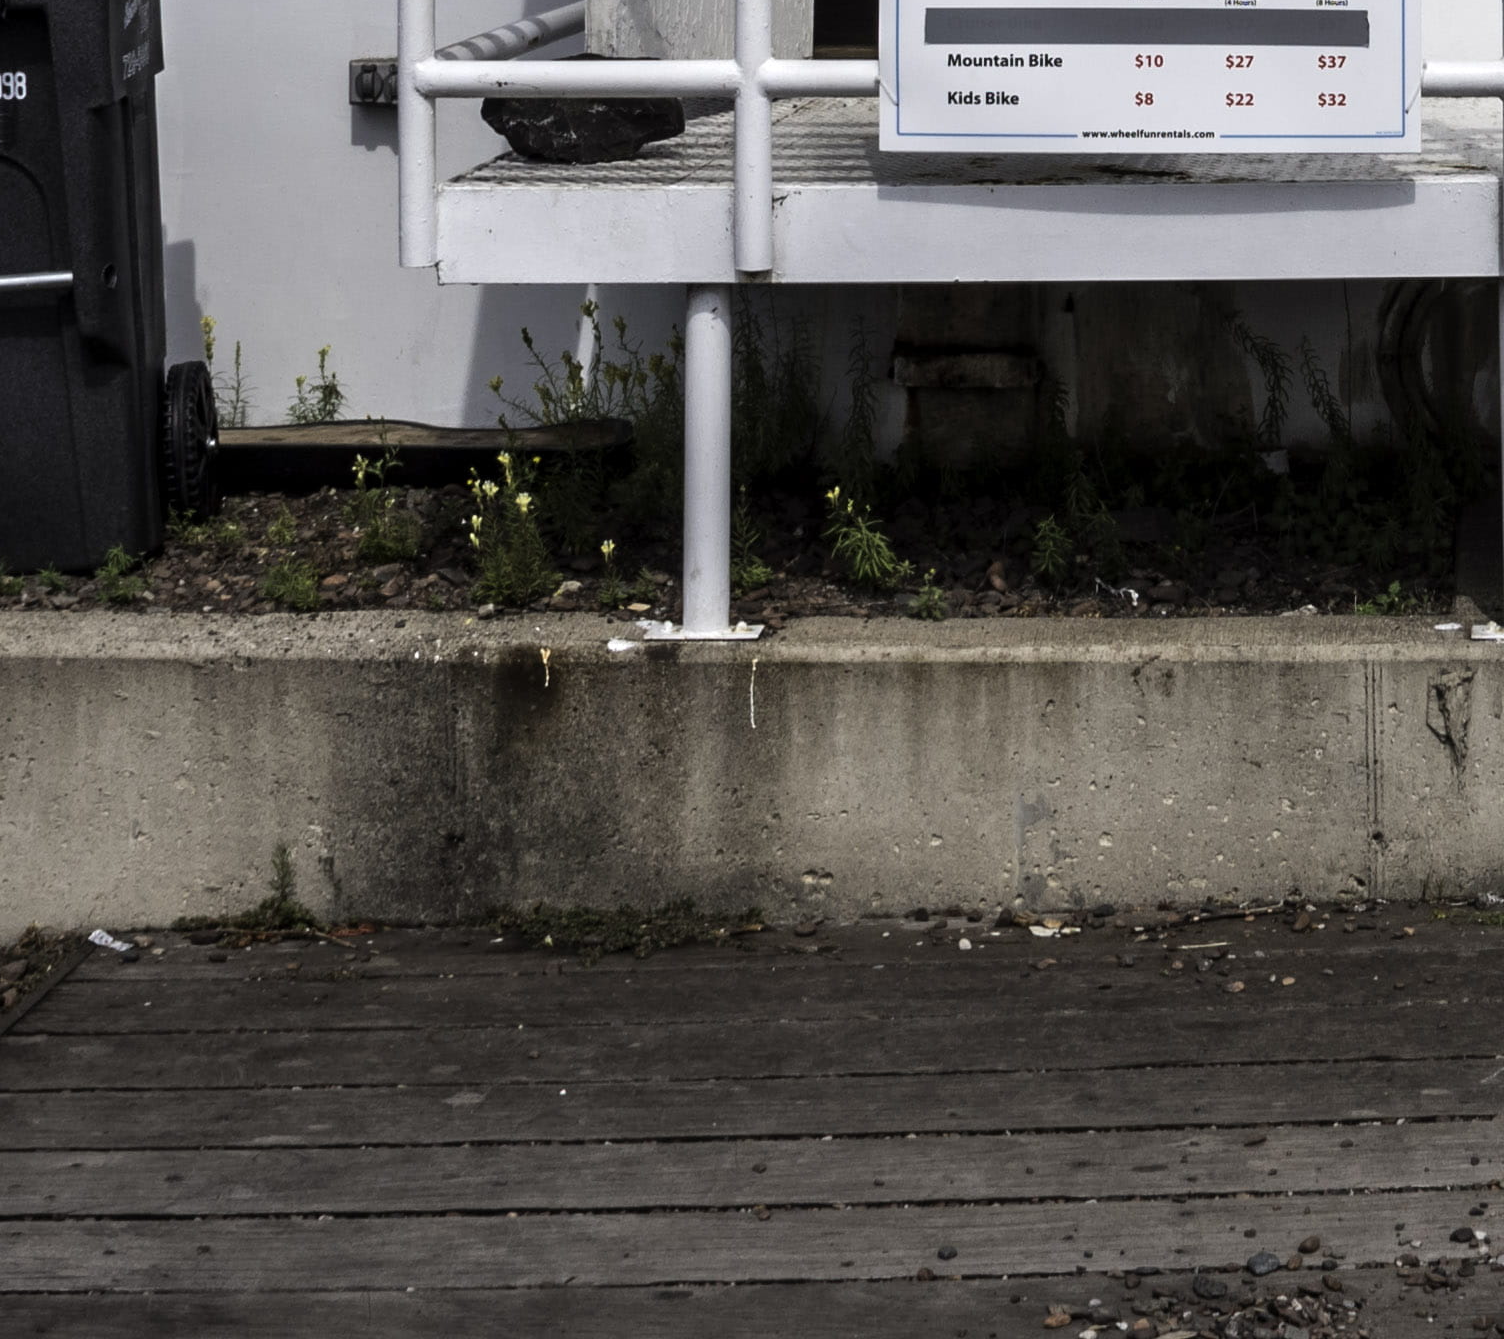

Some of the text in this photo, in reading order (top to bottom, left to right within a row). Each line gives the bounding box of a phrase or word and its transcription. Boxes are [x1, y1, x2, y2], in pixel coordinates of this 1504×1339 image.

[947, 53, 1063, 68] Mountain Bike
[1135, 54, 1347, 70] $10 $27 $37
[947, 90, 1020, 106] Kids Bike
[1135, 92, 1347, 108] $8 $22 $32
[1081, 129, 1215, 140] www.wheelfunrentals.com
